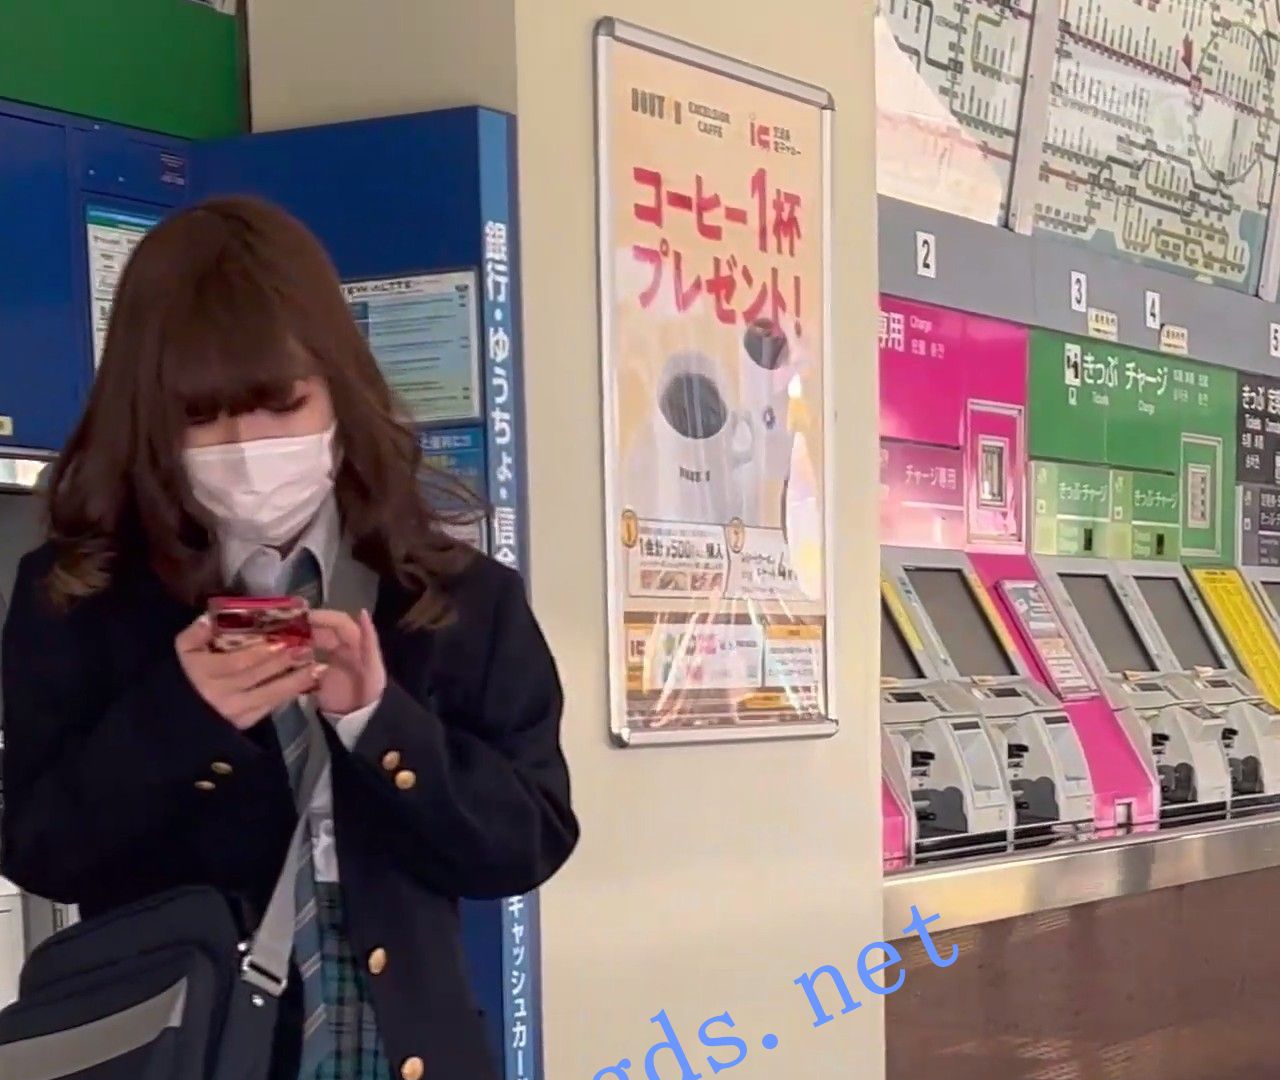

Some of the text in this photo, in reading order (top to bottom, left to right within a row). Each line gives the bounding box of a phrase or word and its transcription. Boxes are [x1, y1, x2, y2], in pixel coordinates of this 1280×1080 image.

[632, 167, 802, 257] コーヒー1杯
[922, 239, 931, 270] 2
[631, 237, 803, 338] プレゼント!
[1075, 277, 1083, 305] 3
[1149, 297, 1157, 322] 4
[1083, 352, 1118, 387] きっぷ
[1125, 361, 1168, 396] チャージ
